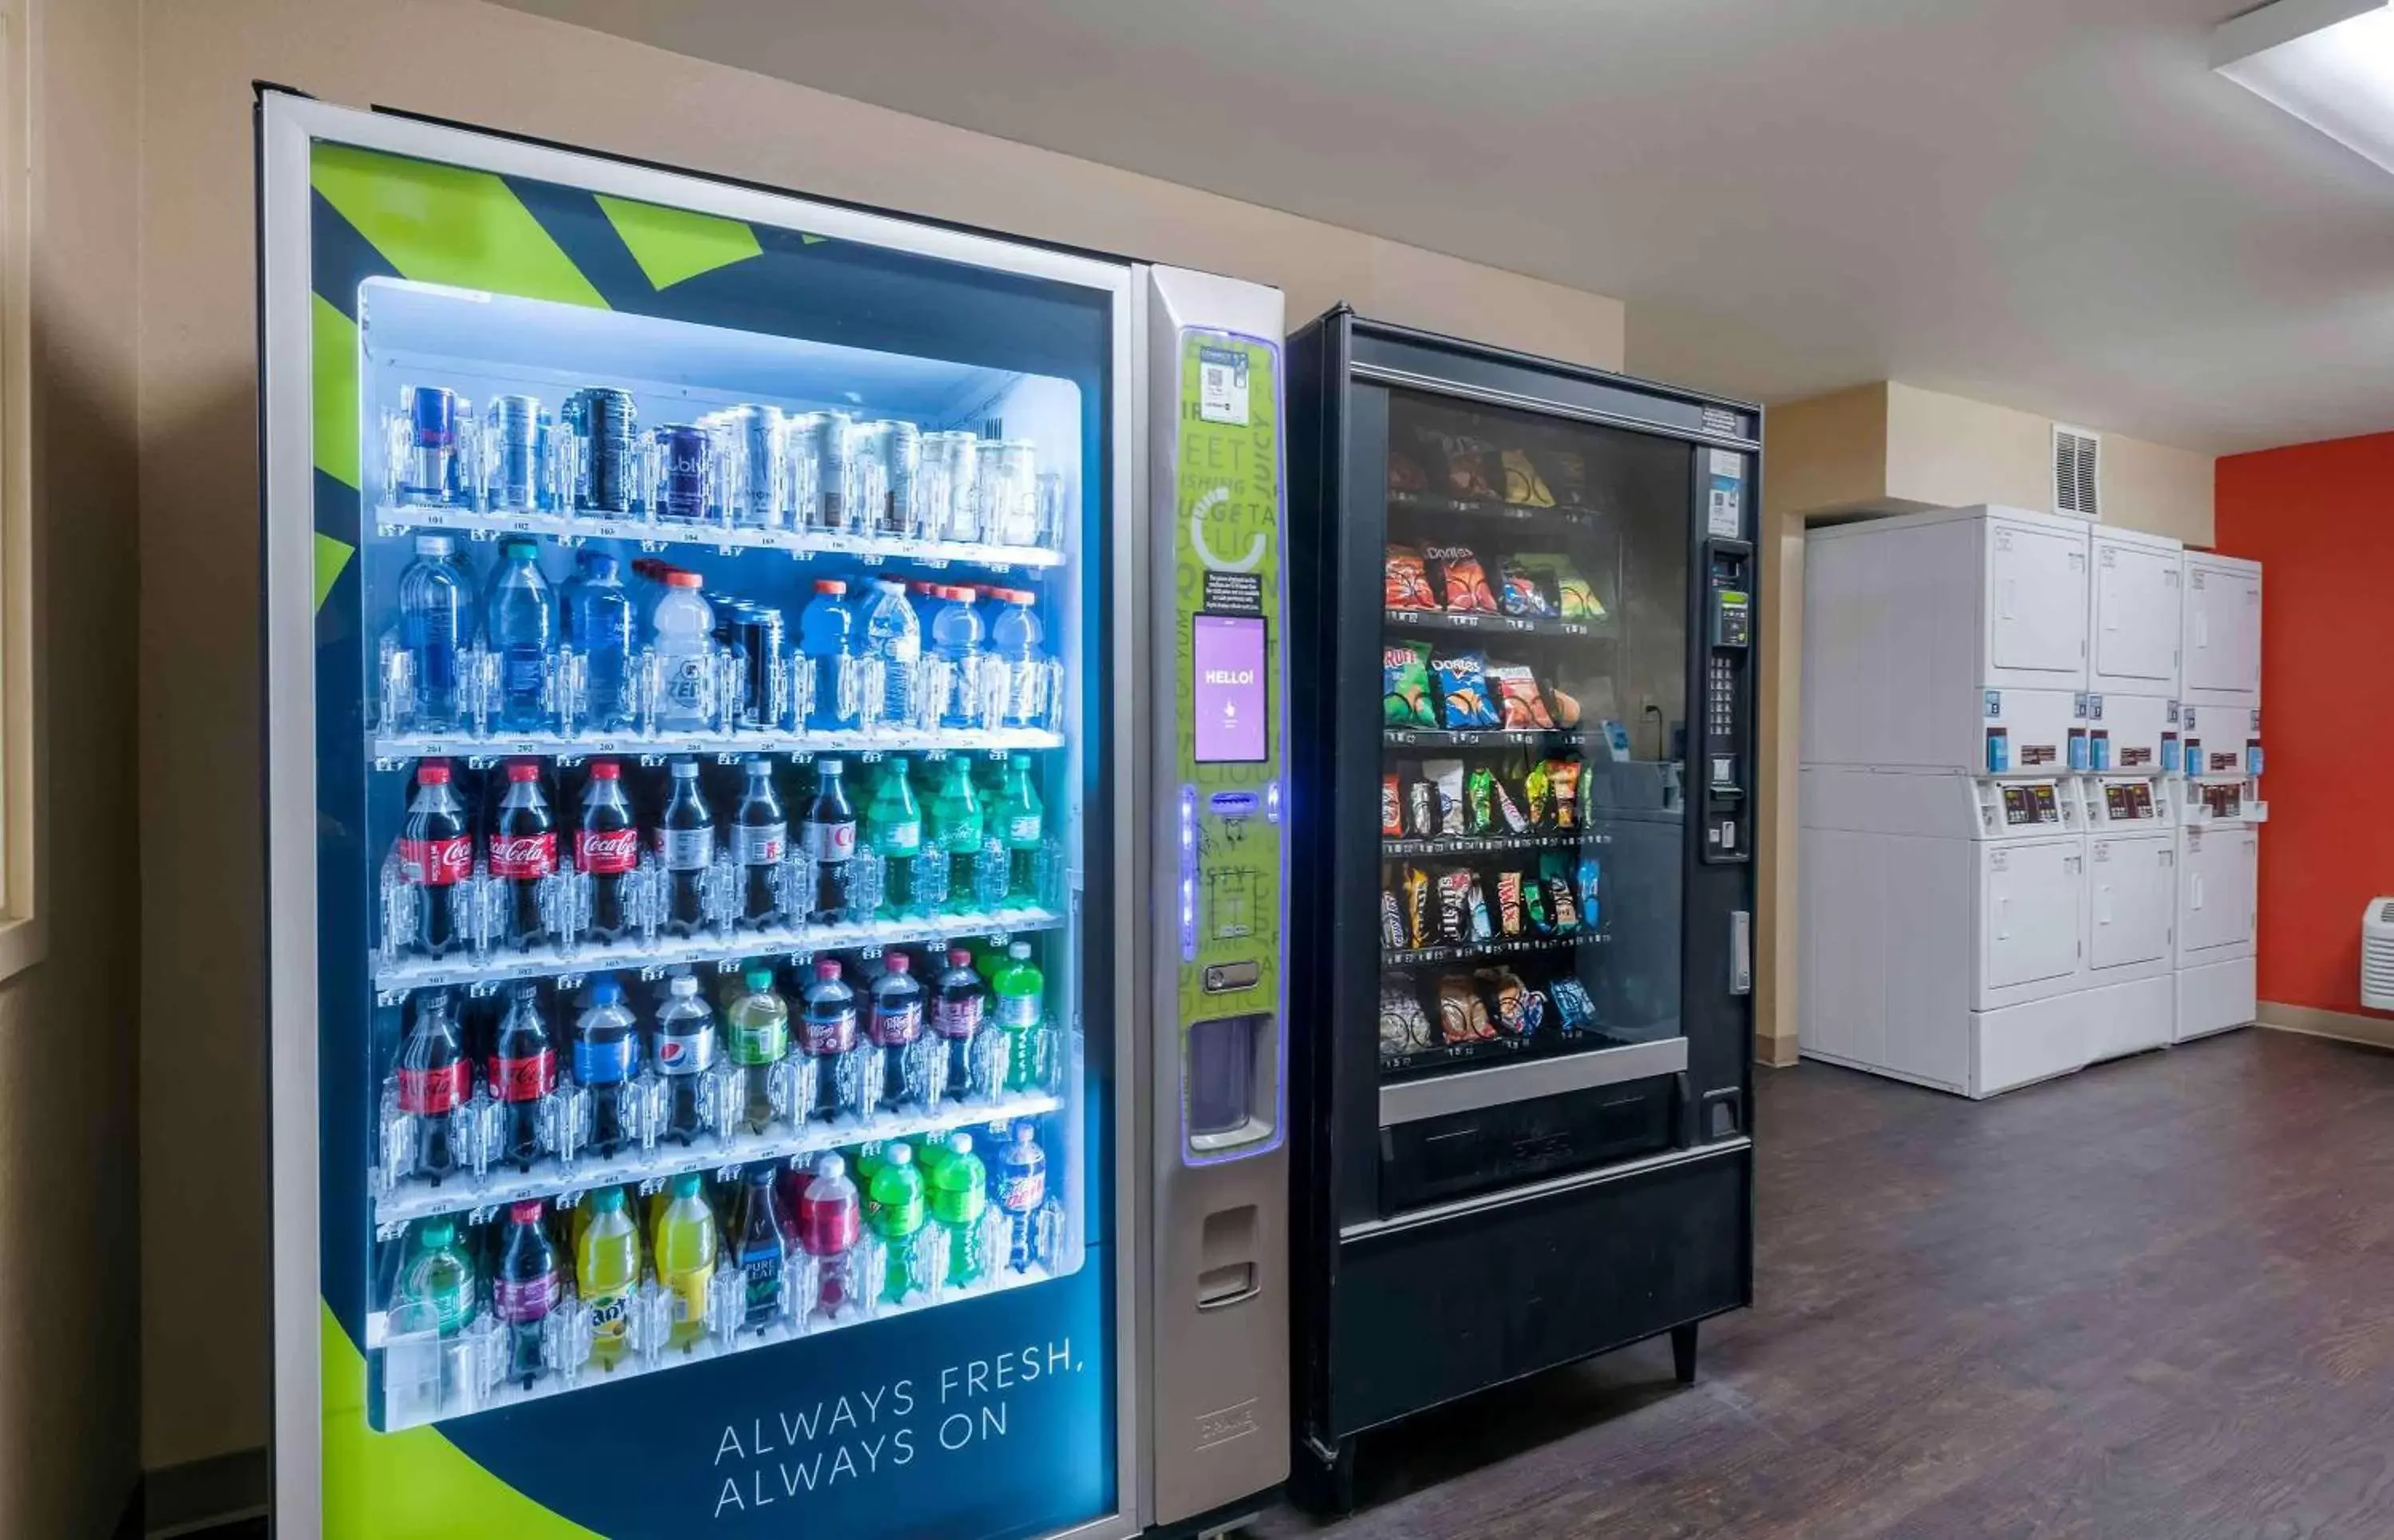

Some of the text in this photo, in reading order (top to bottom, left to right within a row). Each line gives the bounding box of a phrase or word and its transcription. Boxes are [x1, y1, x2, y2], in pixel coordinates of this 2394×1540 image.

[1205, 670, 1254, 685] HELLO!
[745, 1259, 775, 1272] PURE
[714, 1337, 1084, 1466] ALWAYS FRESH,
[714, 1402, 1006, 1518] ALWAYS ON
